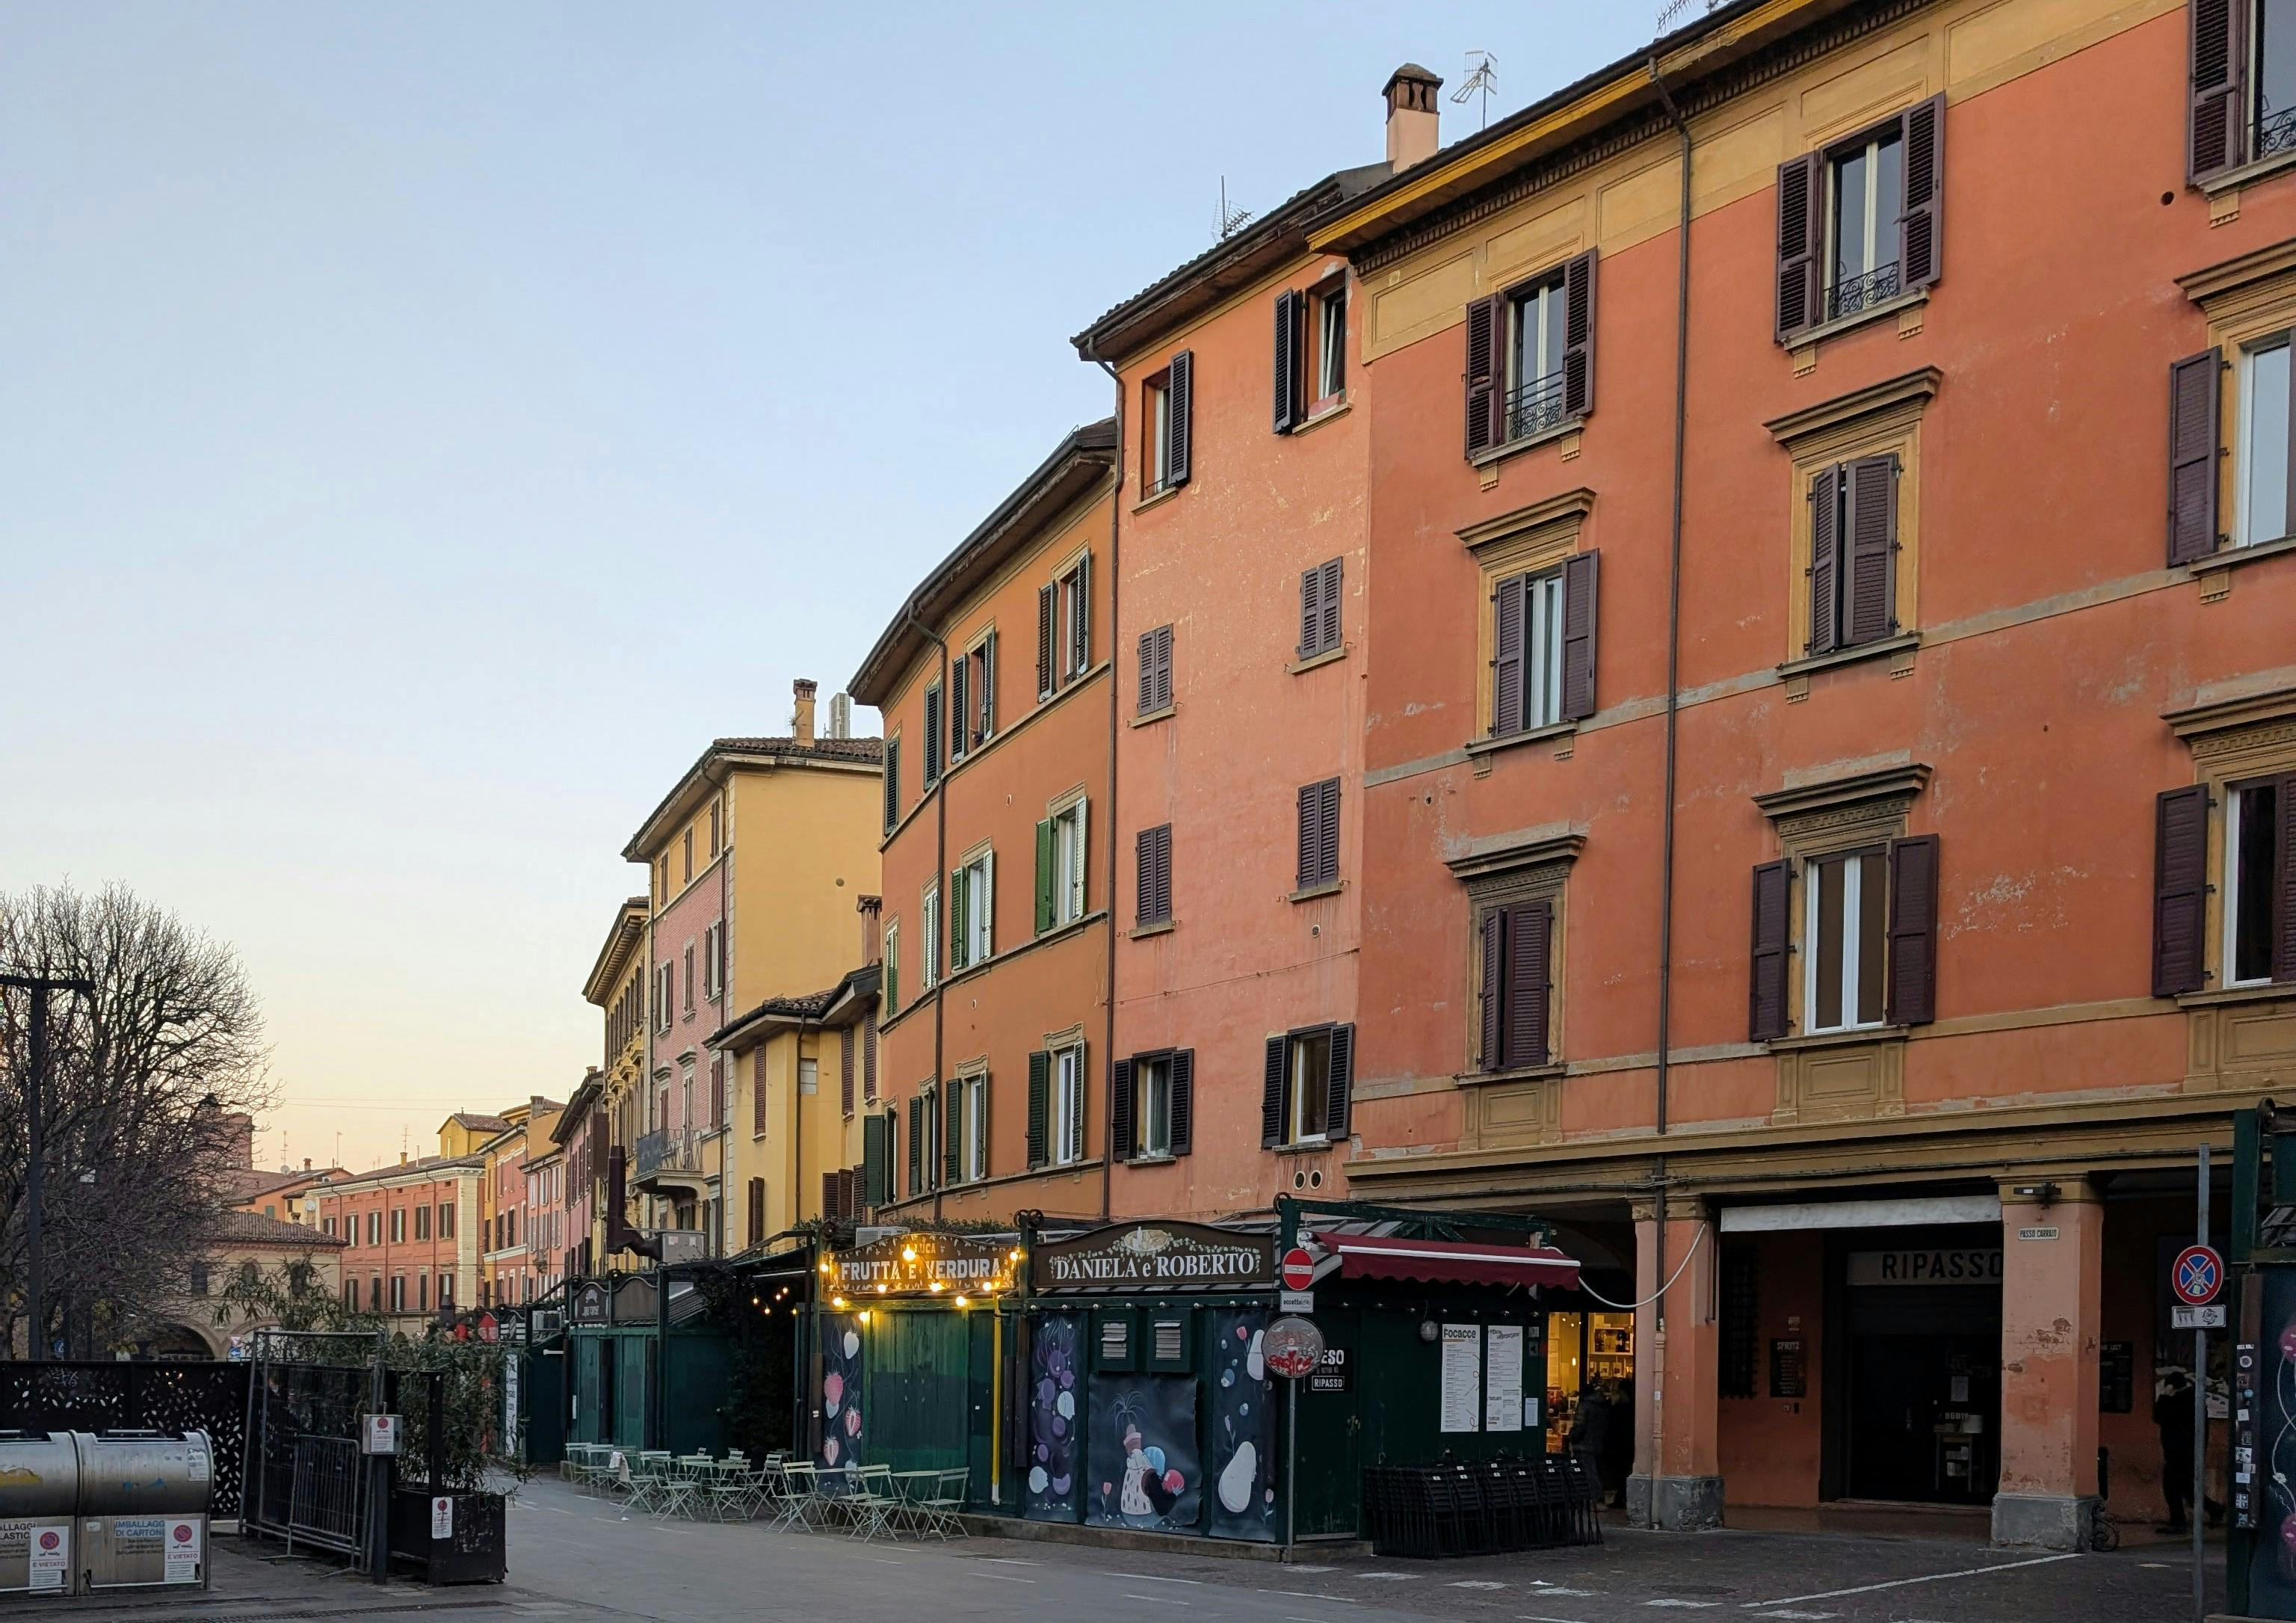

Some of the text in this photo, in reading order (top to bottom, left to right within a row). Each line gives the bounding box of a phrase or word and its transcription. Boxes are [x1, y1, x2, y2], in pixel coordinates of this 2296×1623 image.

[2020, 1230, 2035, 1238] PASSO
[841, 1257, 1002, 1281] FRUTTA E VERDURA
[1056, 1252, 1255, 1280] DANIELA e ROBERTO
[1882, 1251, 2004, 1280] RIPASSO
[1283, 1298, 1302, 1306] eccetto
[1443, 1328, 1477, 1339] Focacce
[1321, 1349, 1345, 1365] ESO
[1314, 1378, 1343, 1388] RIPASSO
[115, 1520, 165, 1528] IMBALLAGG
